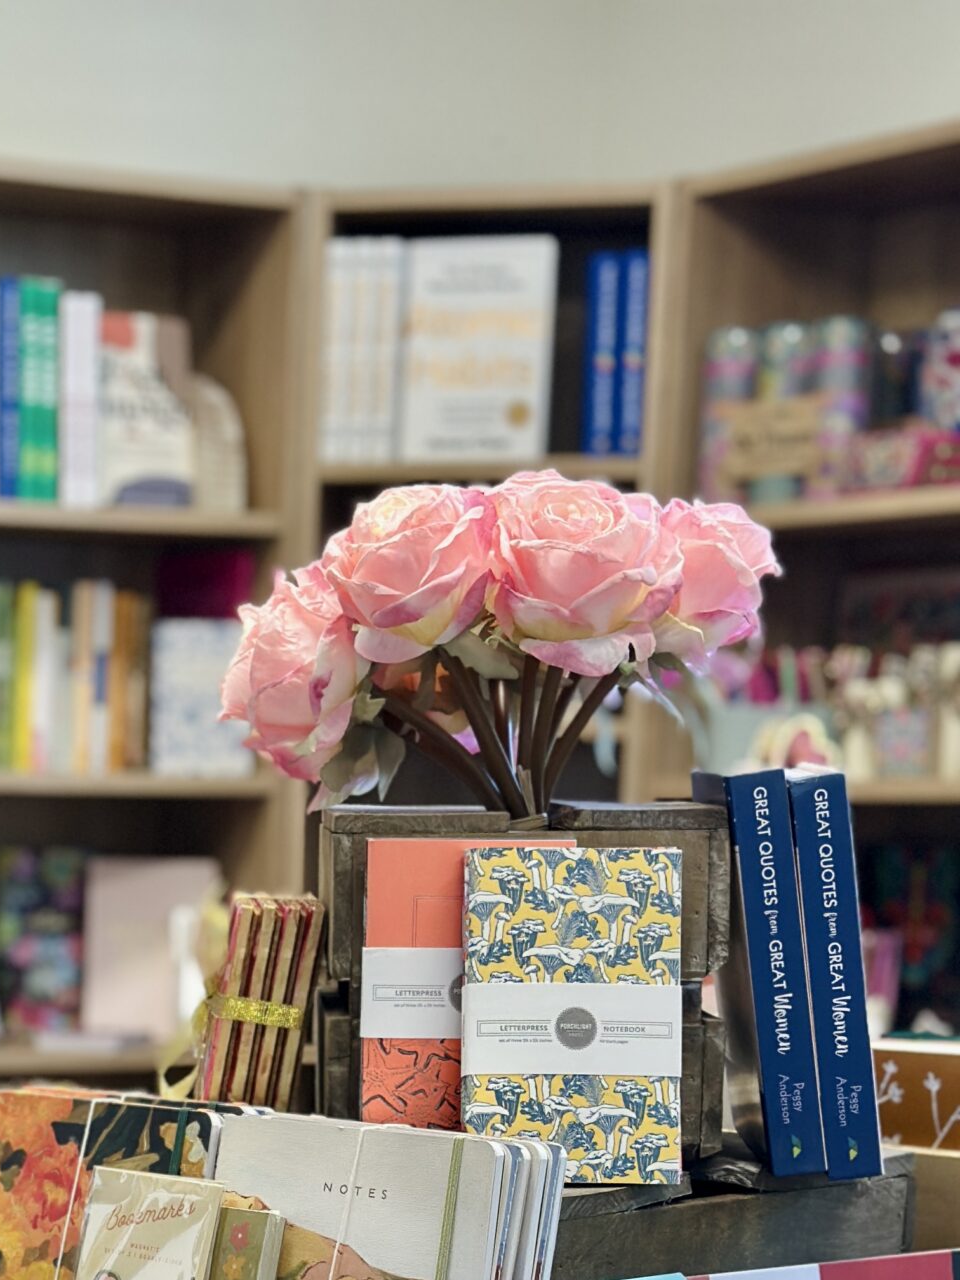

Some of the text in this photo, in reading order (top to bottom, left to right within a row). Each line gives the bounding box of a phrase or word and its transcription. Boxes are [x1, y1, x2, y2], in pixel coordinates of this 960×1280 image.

[753, 786, 793, 1055] GREAT QUOTES from GREAT Women
[814, 788, 852, 1058] GREAT QUOTES from GREAT Women
[395, 989, 442, 997] LETTERPRESS
[778, 1074, 791, 1125] Anderson
[792, 1082, 805, 1112] Peggy
[835, 1076, 848, 1127] Anderson
[849, 1085, 862, 1114] Peggy
[323, 1182, 390, 1200] NOTES
